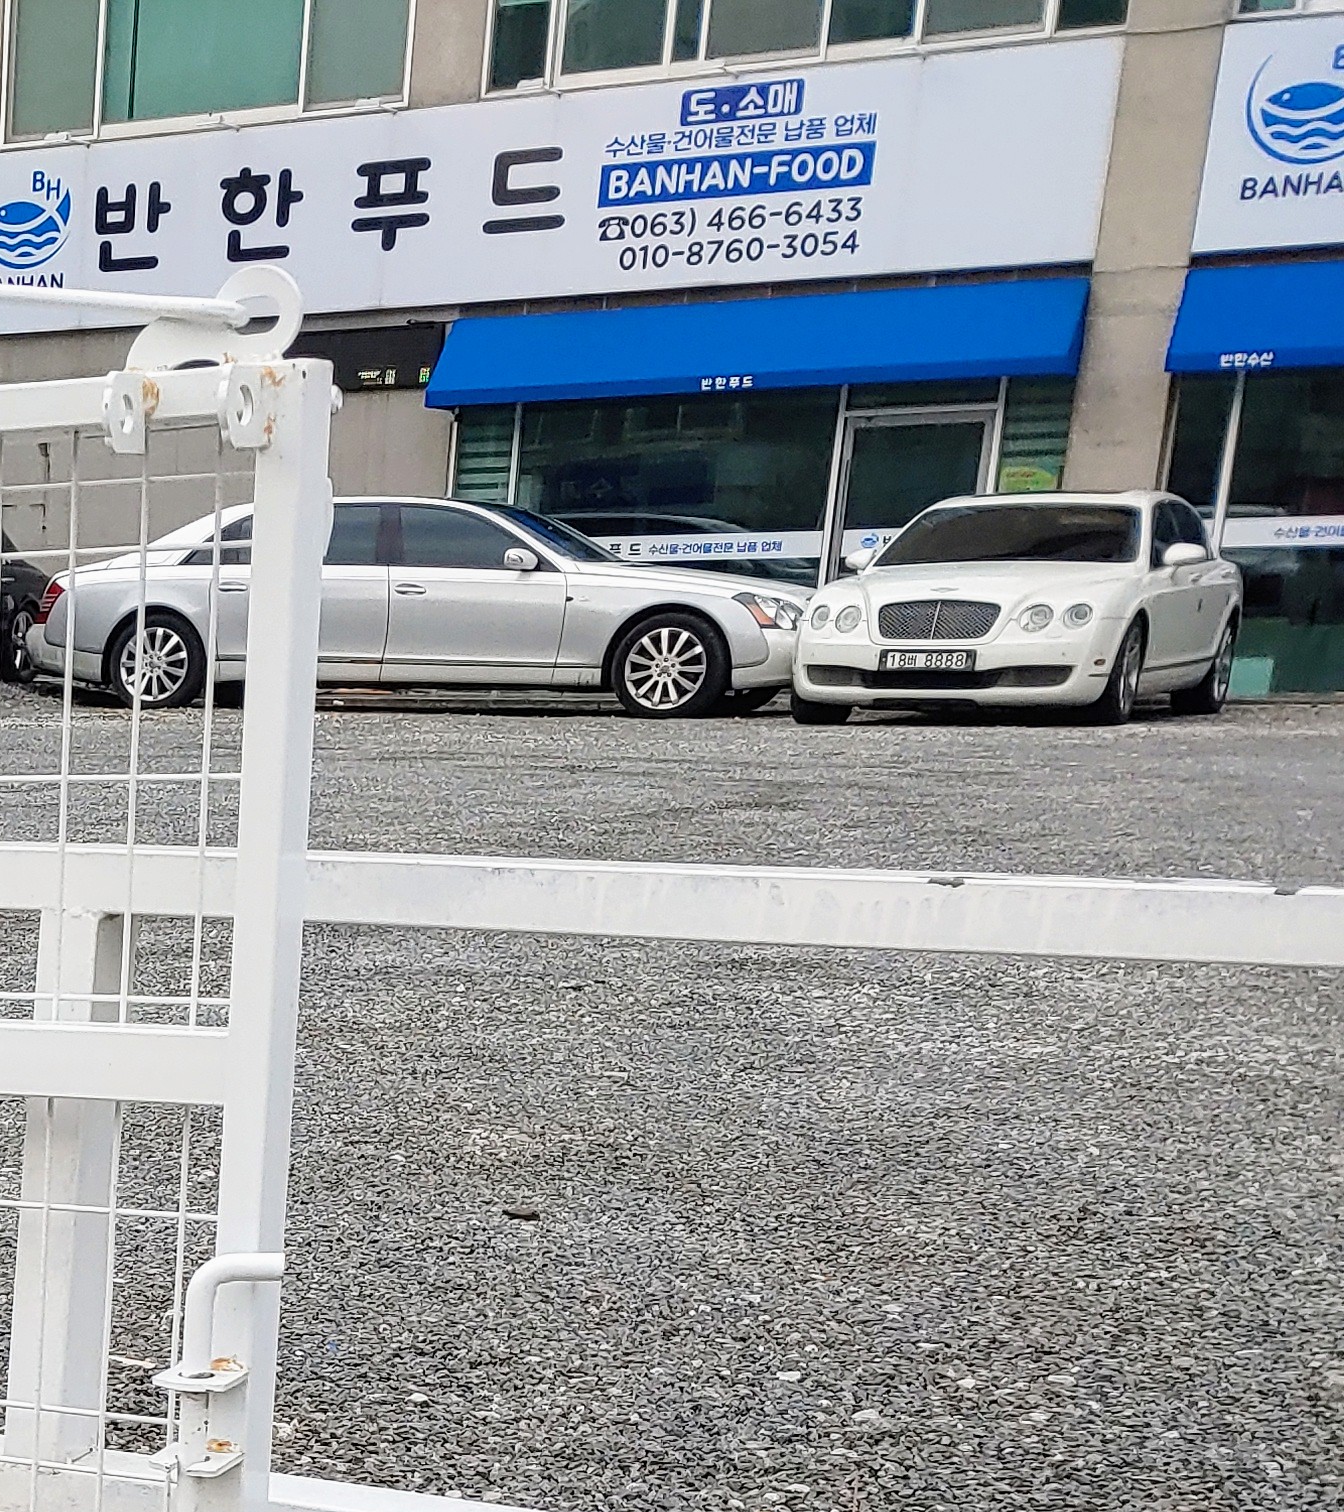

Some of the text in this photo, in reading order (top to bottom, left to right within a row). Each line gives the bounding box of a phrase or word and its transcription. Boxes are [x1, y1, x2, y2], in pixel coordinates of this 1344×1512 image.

[784, 117, 827, 142] 납품
[834, 113, 878, 136] 업체
[608, 148, 865, 200] BANHAN-FOOD
[707, 196, 864, 233] 466-6433
[619, 229, 860, 271] 010-8760-3054
[924, 653, 965, 668] 8888
